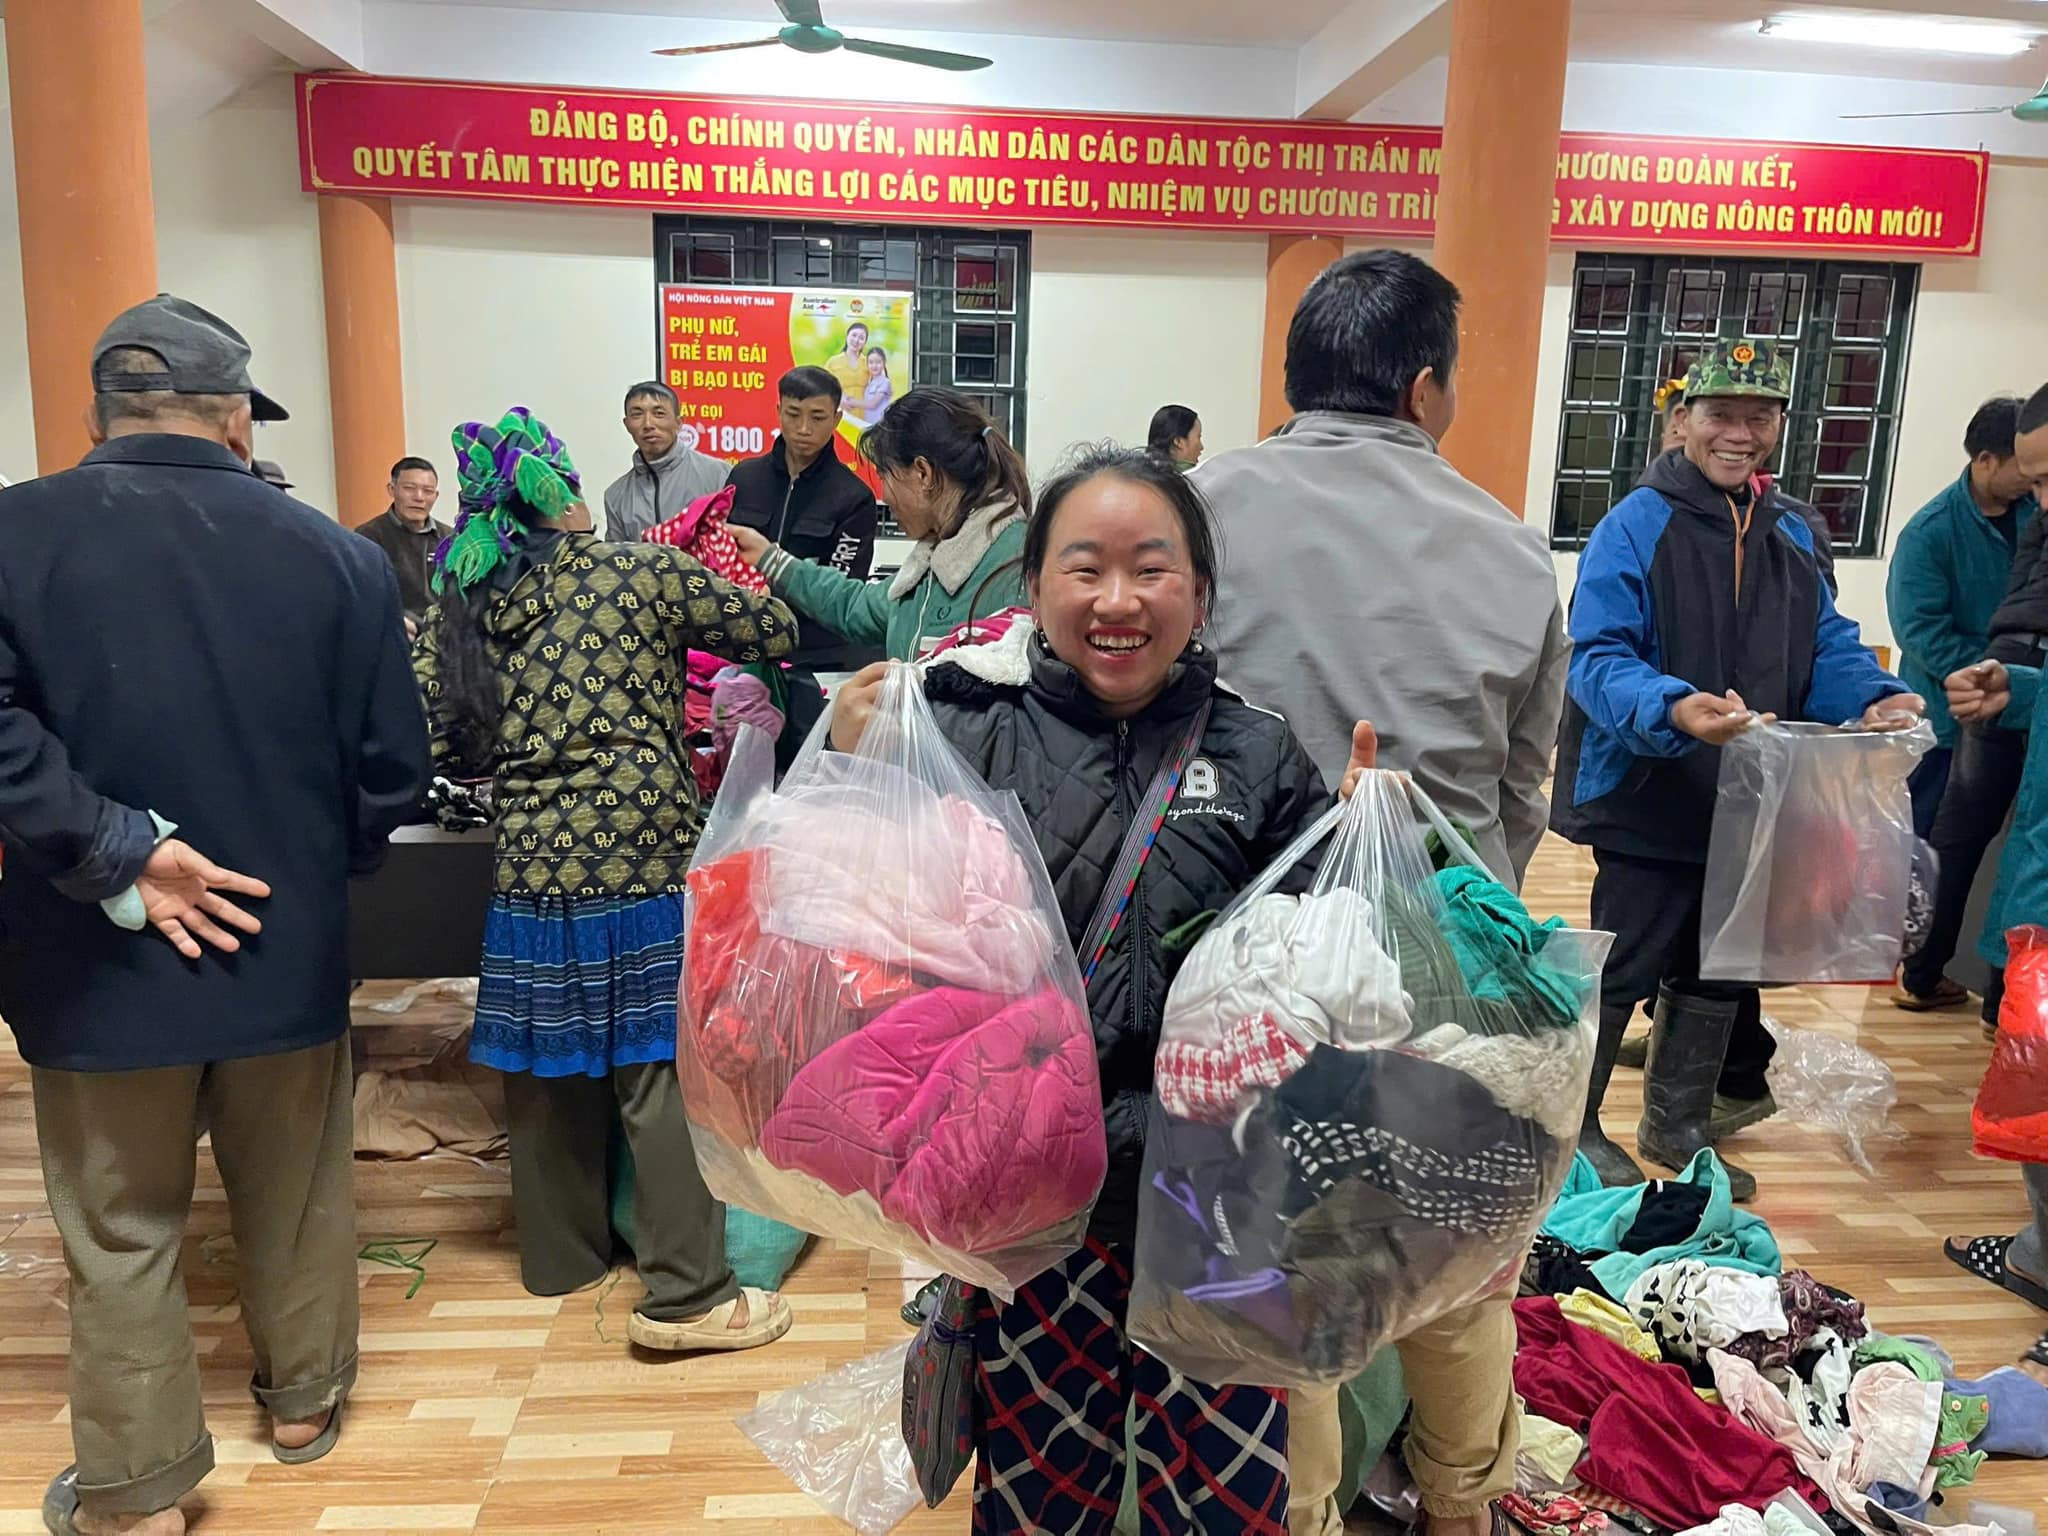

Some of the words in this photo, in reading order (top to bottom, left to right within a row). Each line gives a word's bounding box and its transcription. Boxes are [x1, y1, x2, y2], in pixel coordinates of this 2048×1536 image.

[530, 100, 617, 140] ĐẢNG
[627, 109, 678, 148] BỘ,
[688, 113, 785, 149] CHÍNH
[794, 117, 905, 157] QUYỀN,
[914, 124, 999, 158] NHÂN
[1008, 127, 1069, 160] DÂN
[1079, 130, 1137, 163] CÁC
[1147, 133, 1207, 166] DÂN
[1216, 136, 1270, 173] TỘC
[1280, 143, 1324, 176] THỊ
[1334, 136, 1409, 173] TRẤN
[1555, 151, 1649, 182] HƯƠNG
[1656, 153, 1735, 186] ĐOÀN
[1740, 153, 1796, 191] KẾT,
[354, 142, 453, 179] QUYẾT
[462, 149, 529, 183] TÂM
[539, 157, 619, 192] THỰC
[629, 158, 703, 197] HIỆN
[712, 157, 814, 197] THẮNG
[823, 171, 871, 205] LỢI
[879, 169, 939, 203] CÁC
[948, 176, 1015, 210] MỤC
[1024, 174, 1098, 211] TIÊU,
[1108, 180, 1204, 217] NHIỆM
[1214, 186, 1249, 220] VỤ
[1260, 187, 1377, 217] CHƯƠNG
[1568, 193, 1624, 226] XÂY
[1631, 200, 1709, 234] DỰNG
[1716, 199, 1794, 232] NÔNG
[1802, 203, 1873, 235] THÔN
[1880, 206, 1942, 237] MỚI!
[669, 292, 685, 304] HỘI
[686, 292, 711, 304] NÔNG
[713, 294, 732, 305] DÂN
[734, 295, 752, 307] VIỆT
[754, 297, 775, 306] NAM
[670, 316, 704, 337] PHỤ
[709, 315, 739, 337] NỮ,
[670, 338, 701, 361] TRẺ
[706, 344, 733, 362] EM
[738, 343, 767, 363] GÁI
[670, 369, 688, 389] BỊ
[693, 370, 728, 390] BẠO
[732, 371, 765, 392] LỰC
[680, 401, 697, 417] ÃY
[700, 404, 723, 420] GỌI
[707, 425, 763, 453] 1800
